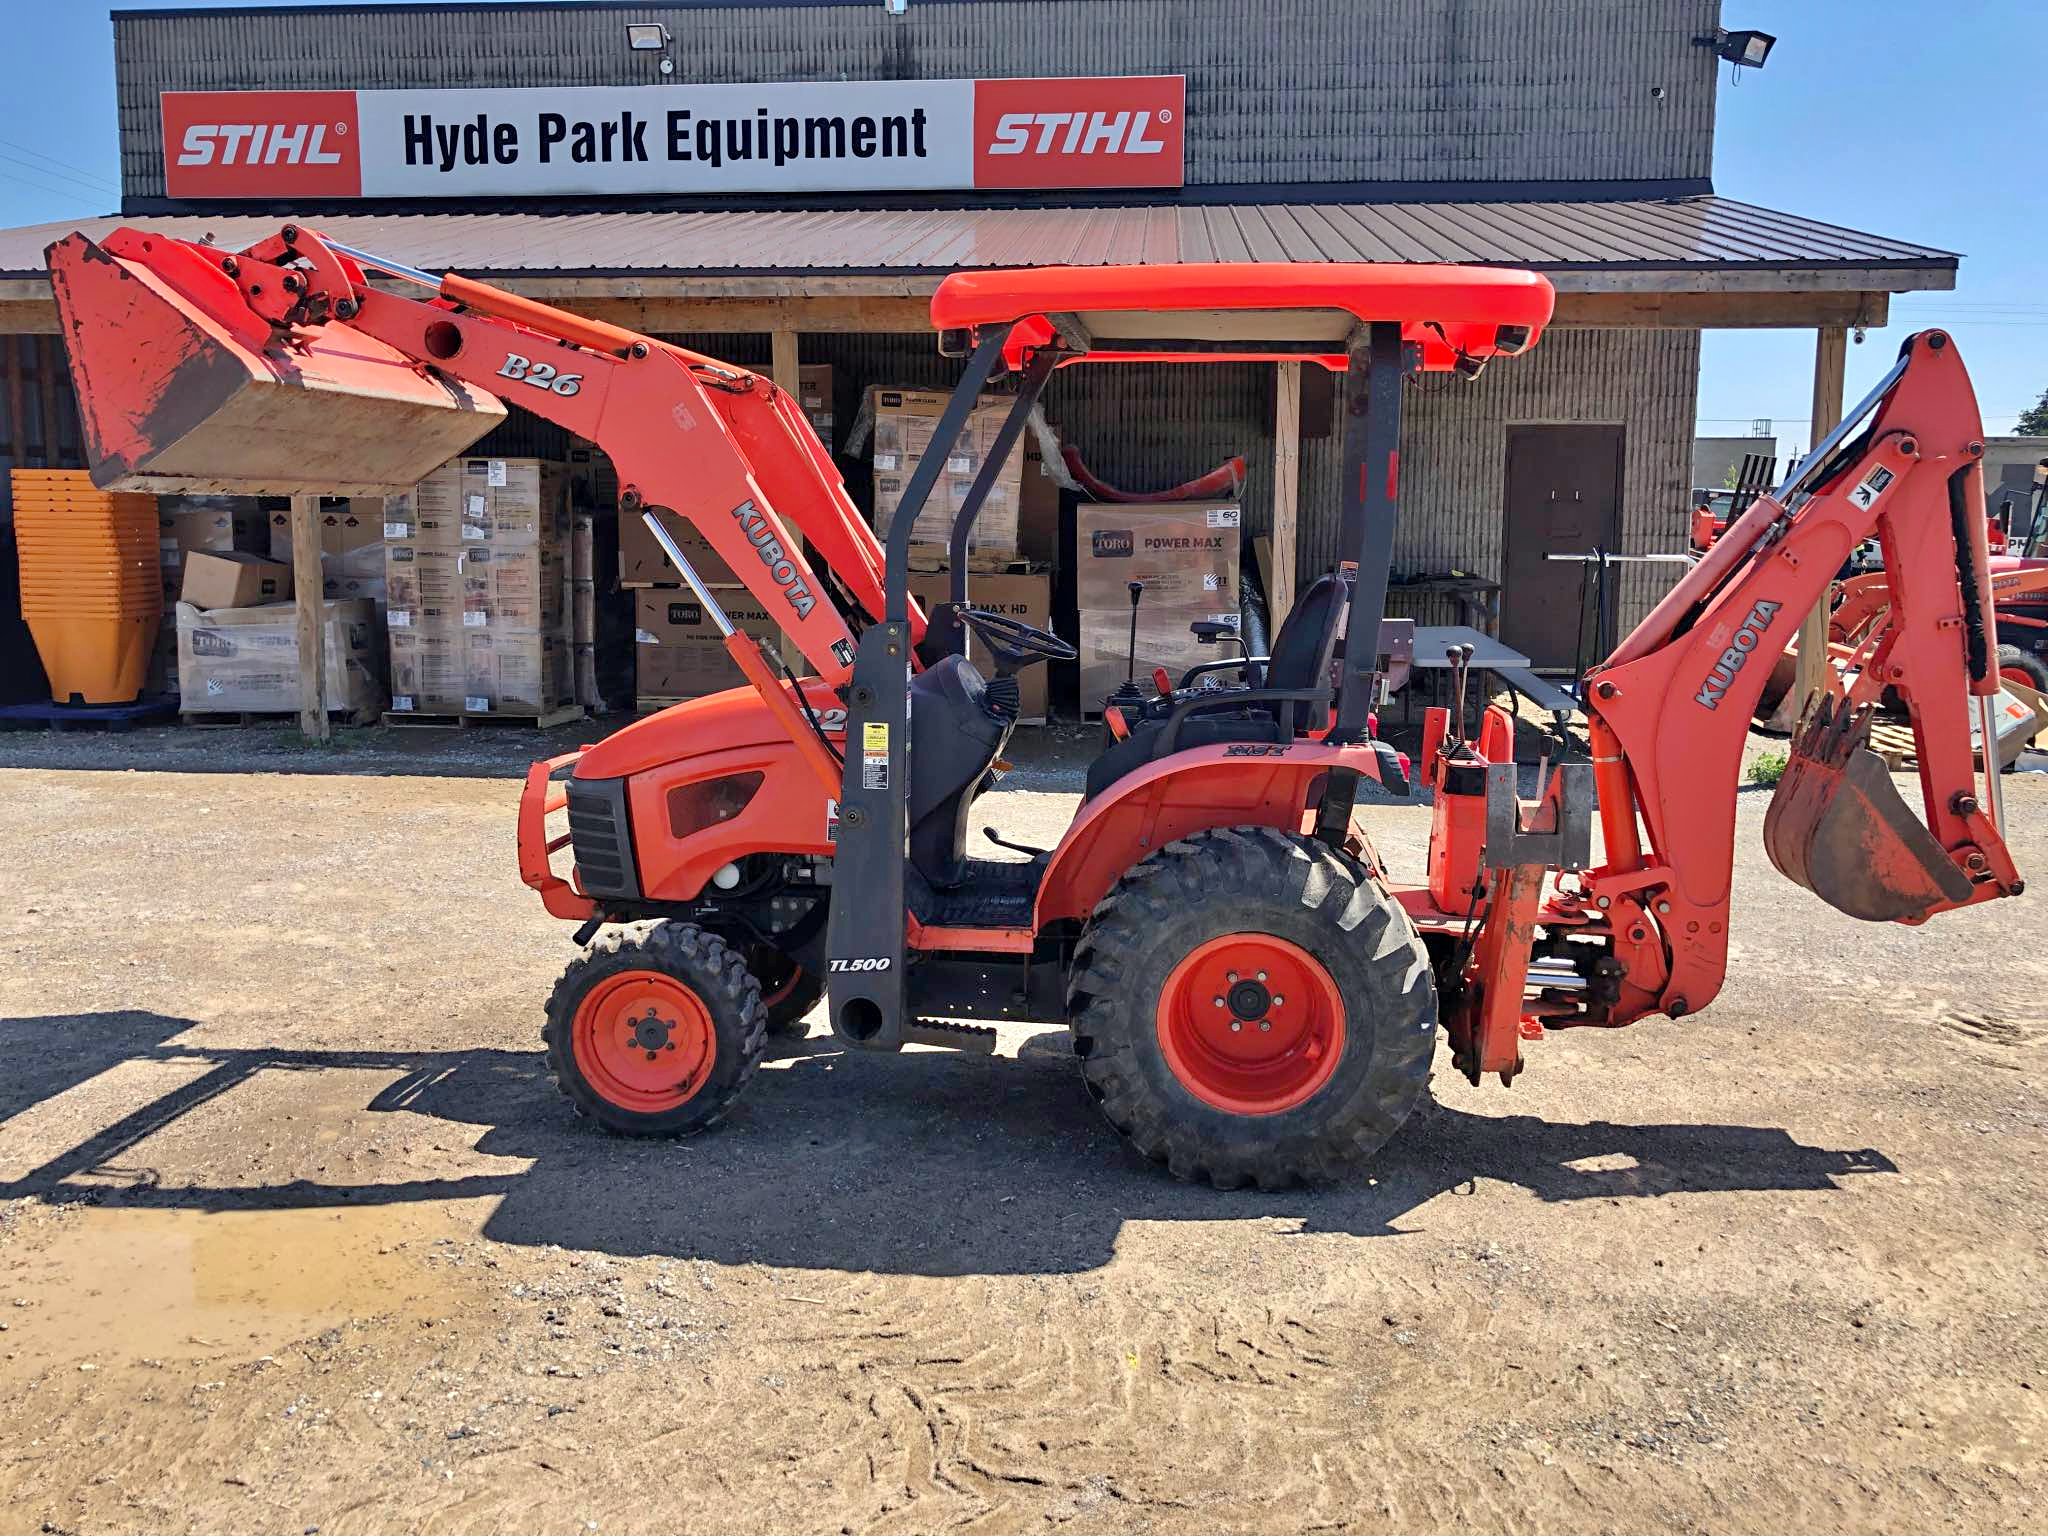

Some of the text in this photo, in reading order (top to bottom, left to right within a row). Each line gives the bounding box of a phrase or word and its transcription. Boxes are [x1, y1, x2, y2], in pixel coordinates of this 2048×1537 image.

[403, 107, 927, 173] Hyde Park Equipment
[988, 110, 1165, 155] STIHL
[177, 124, 341, 166] STIHL
[496, 352, 585, 397] B26
[1026, 451, 1043, 462] HD
[1096, 538, 1130, 550] TORO
[1144, 536, 1223, 549] POWER MAX
[731, 499, 817, 622] KUBOTA
[670, 608, 699, 620] TORO
[747, 610, 769, 621] MAX
[980, 604, 1006, 615] MAX
[1011, 603, 1028, 615] HD
[1695, 600, 1784, 711] KUBOTA
[830, 957, 892, 973] TL500
